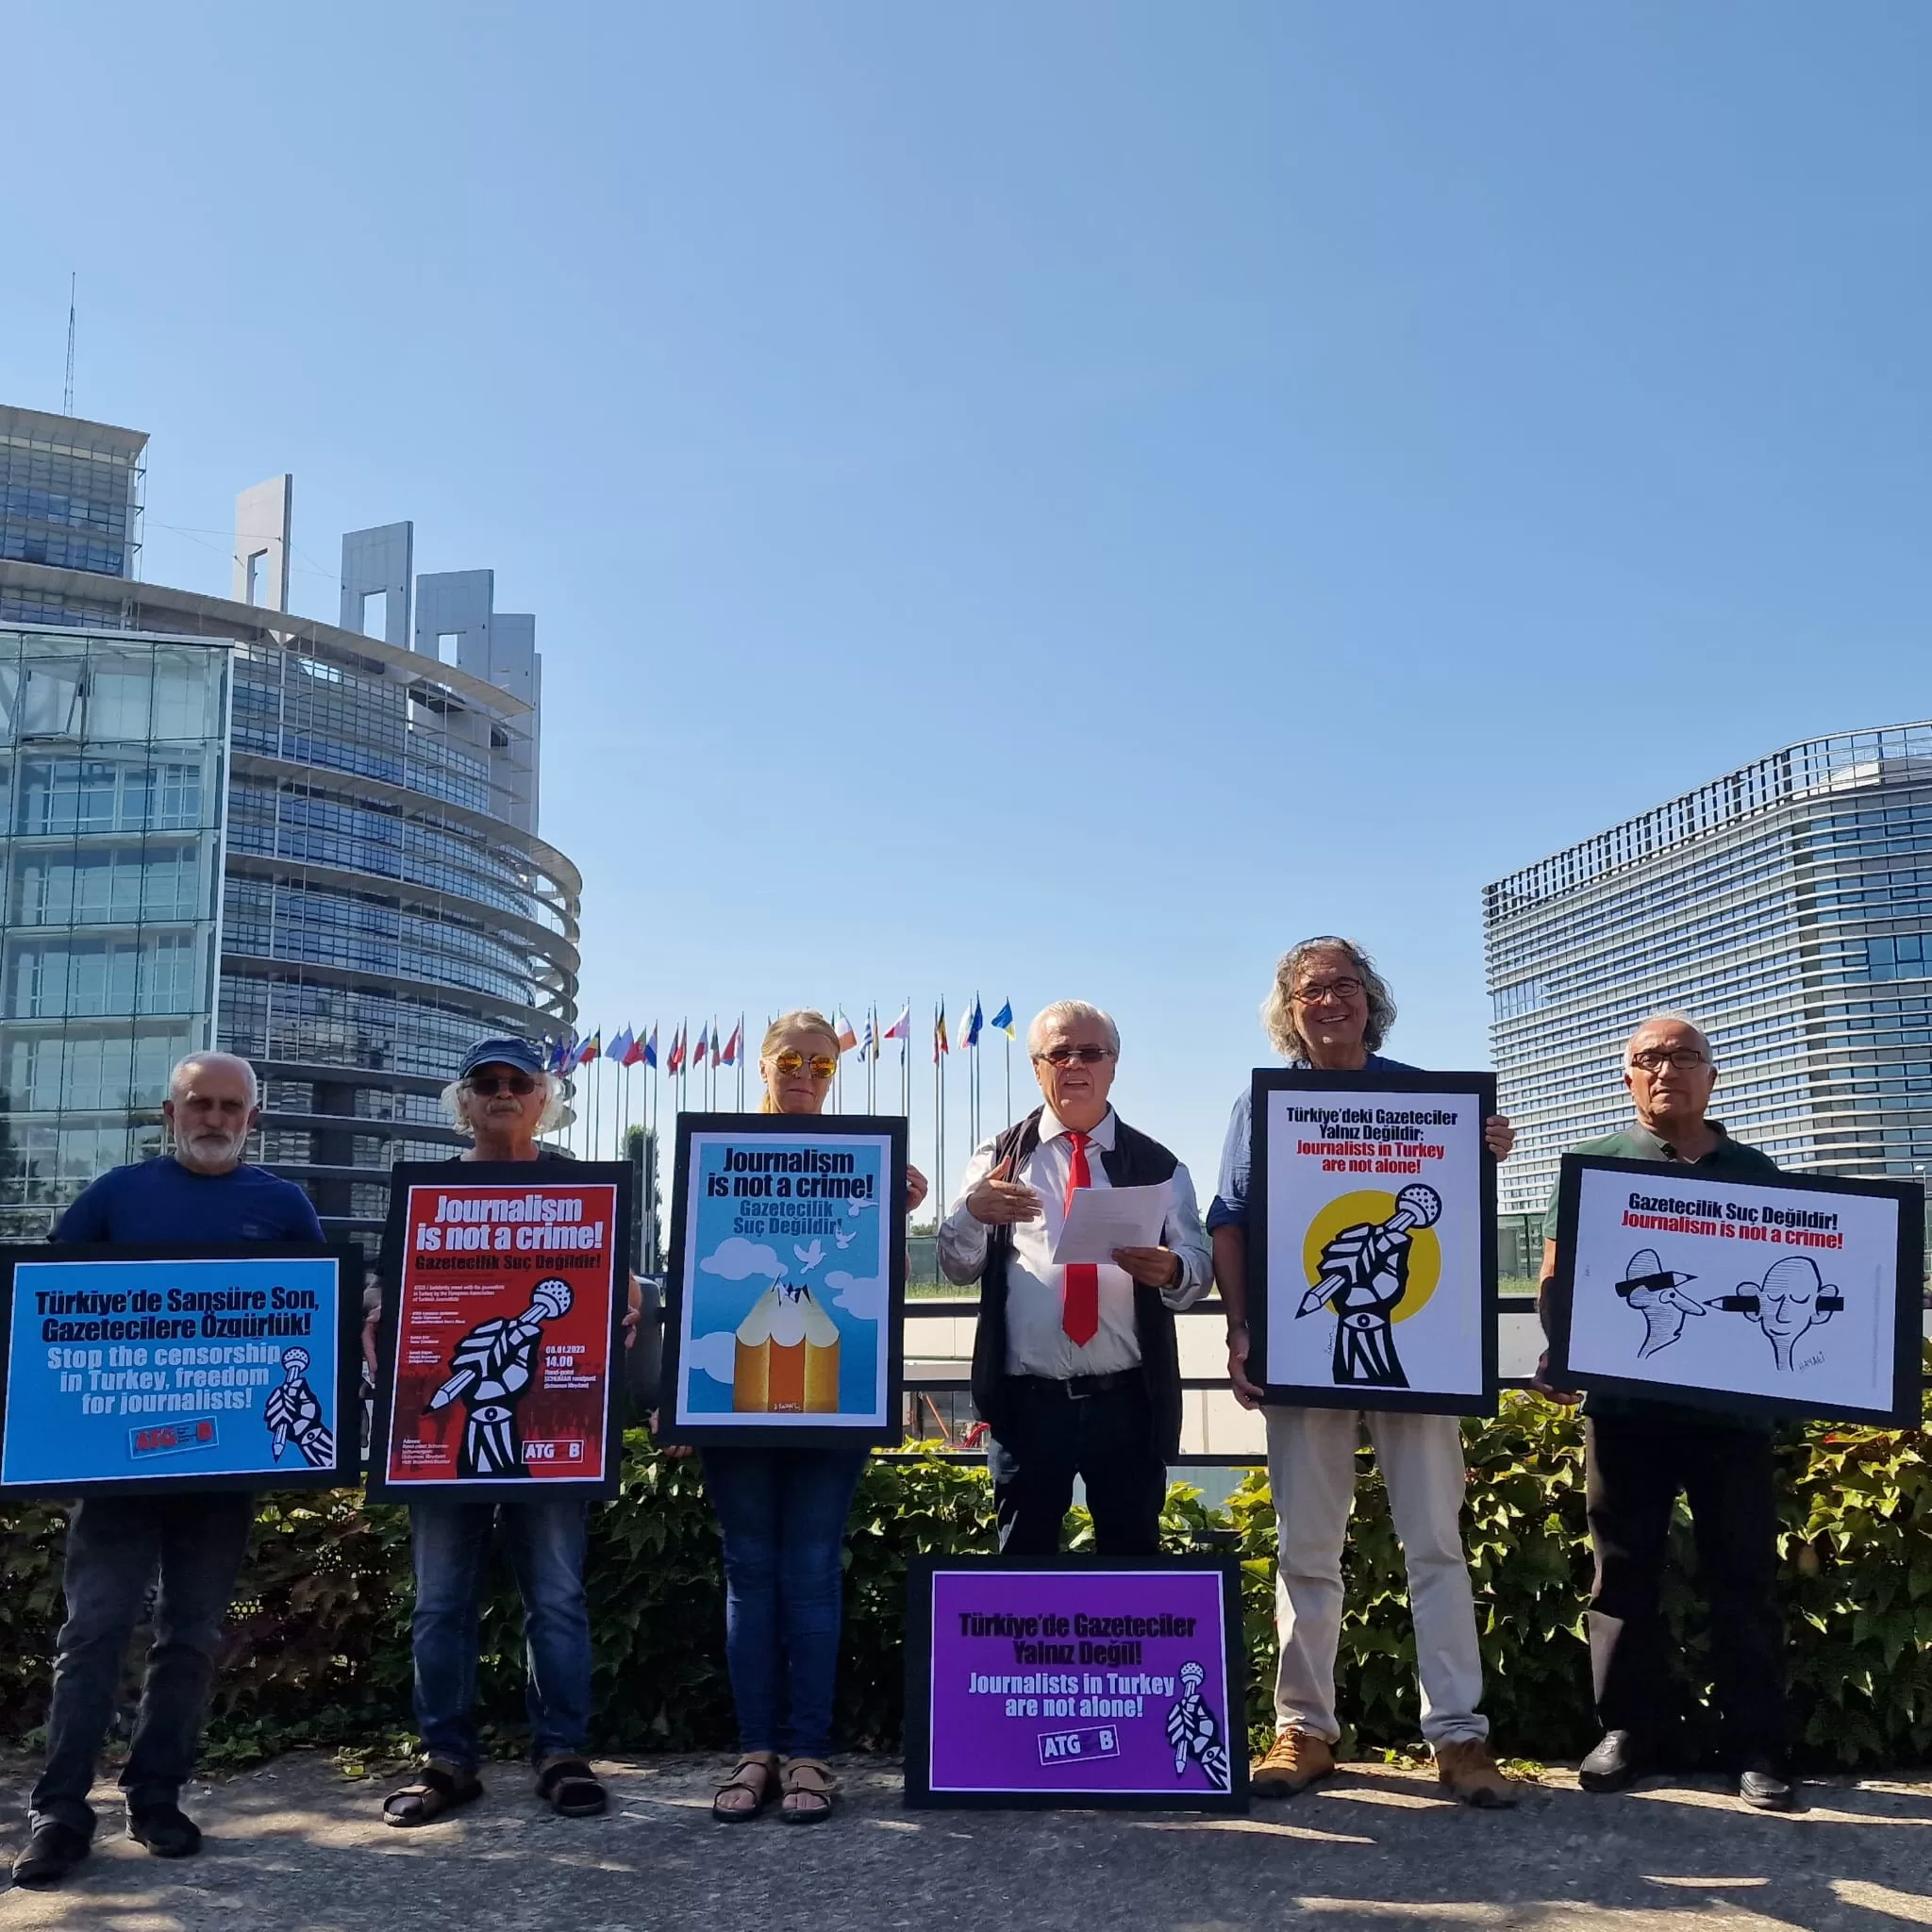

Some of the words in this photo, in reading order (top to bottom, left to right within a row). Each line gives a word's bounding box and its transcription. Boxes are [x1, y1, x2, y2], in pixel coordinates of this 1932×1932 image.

[1287, 1108, 1373, 1124] Türkiye'deki
[1376, 1108, 1458, 1125] Gazeteciler
[1320, 1124, 1360, 1140] Yalnız
[1363, 1124, 1424, 1141] Değildir:
[723, 1147, 854, 1174] Journalism
[1296, 1140, 1375, 1157] Journalists
[1378, 1142, 1391, 1157] in
[1394, 1142, 1444, 1159] Turkey
[1323, 1159, 1345, 1172] are
[1349, 1159, 1373, 1173] not
[1375, 1158, 1421, 1174] alone!
[708, 1173, 729, 1197] is
[734, 1174, 772, 1197] not
[776, 1177, 791, 1197] a
[796, 1173, 874, 1199] crime!
[435, 1194, 583, 1224] Journalism
[740, 1200, 833, 1217] Gazetecilik
[1628, 1192, 1723, 1219] Gazetecilik
[1725, 1202, 1758, 1225] Suç
[1762, 1207, 1839, 1230] Değildir!
[416, 1223, 441, 1251] is
[445, 1224, 491, 1251] not
[494, 1226, 511, 1250] a
[516, 1222, 604, 1250] crime!
[734, 1217, 765, 1237] Suç
[769, 1216, 841, 1237] Değildir!
[1622, 1210, 1717, 1237] Journalism
[1720, 1221, 1736, 1238] is
[1739, 1224, 1768, 1241] not
[1771, 1229, 1782, 1243] a
[1785, 1228, 1843, 1249] crime!
[415, 1255, 500, 1270] Gazetecilik
[504, 1256, 531, 1272] Suç
[536, 1254, 601, 1271] Değildir!
[35, 1290, 162, 1316] Türkiye'de
[271, 1286, 320, 1311] Son,
[42, 1317, 196, 1343] Gazetecilere
[201, 1309, 311, 1341] Özgürlük!
[47, 1346, 102, 1370] Stop
[108, 1345, 147, 1368] the
[154, 1342, 281, 1367] censorship
[59, 1371, 82, 1392] in
[89, 1369, 170, 1391] Turkey,
[175, 1366, 269, 1388] freedom
[82, 1392, 116, 1415] for
[119, 1388, 253, 1416] journalists!
[525, 1443, 555, 1458] ATG
[569, 1442, 580, 1458] B
[958, 1612, 1070, 1640] Türkiye'de
[1074, 1613, 1196, 1638] Gazeteciler
[1012, 1641, 1074, 1665] Yalnız
[1079, 1640, 1142, 1668] Değil!
[969, 1673, 1079, 1694] Journalists
[1084, 1674, 1102, 1694] in
[1107, 1673, 1174, 1697] Turkey
[1006, 1698, 1039, 1717] are
[1043, 1697, 1075, 1717] not
[1080, 1695, 1143, 1718] alone!
[1044, 1734, 1081, 1757] ATG
[1099, 1730, 1114, 1750] B
